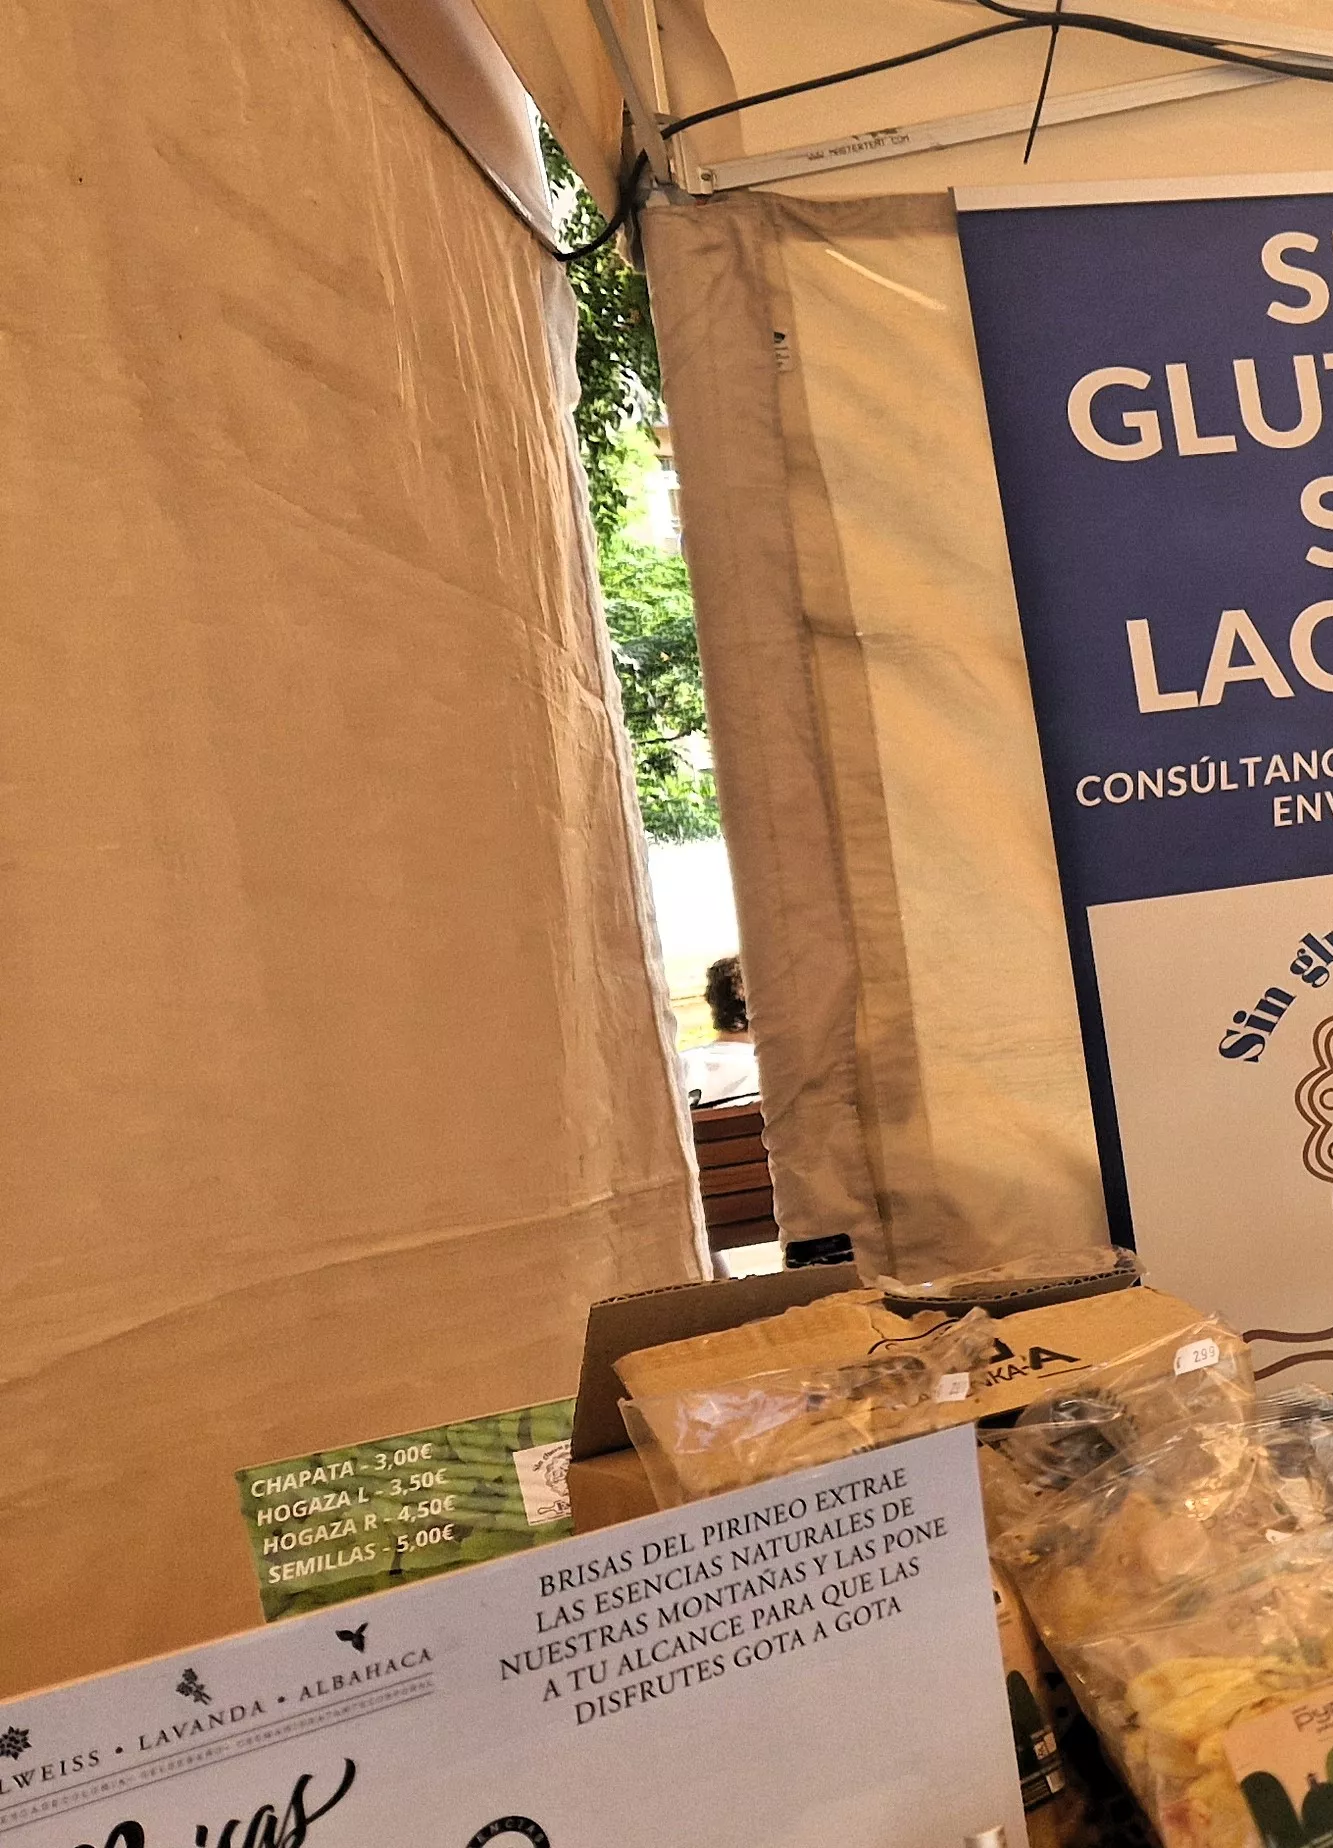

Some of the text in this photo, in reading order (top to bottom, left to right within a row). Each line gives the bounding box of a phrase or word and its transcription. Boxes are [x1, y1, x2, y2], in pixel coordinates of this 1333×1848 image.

[1219, 986, 1297, 1063] Sin
[251, 1460, 354, 1498] CHAPATA
[374, 1442, 433, 1473] 3,00€
[256, 1489, 351, 1527] HOGAZA
[357, 1488, 370, 1504] L
[389, 1467, 449, 1499] 3,50€
[262, 1517, 358, 1556] HOGAZA
[364, 1513, 379, 1532] R
[397, 1494, 457, 1524] 4,50€
[539, 1467, 908, 1597] BRISAS DEL PIRINEO EXTRAE
[267, 1542, 376, 1585] SEMILLAS
[396, 1522, 456, 1555] 5,00€
[499, 1516, 949, 1681] NUESTRAS MONTAÑAS Y LAS PONE
[535, 1496, 915, 1633] LAS ESENCIAS NATURALES DE
[542, 1556, 921, 1702] A TU ALCANCE PARA QUE LAS
[575, 1595, 902, 1726] DISFRUTES GOTA A GOTA
[0, 1646, 434, 1795] LWEISS LAVANDA ALBAHACA
